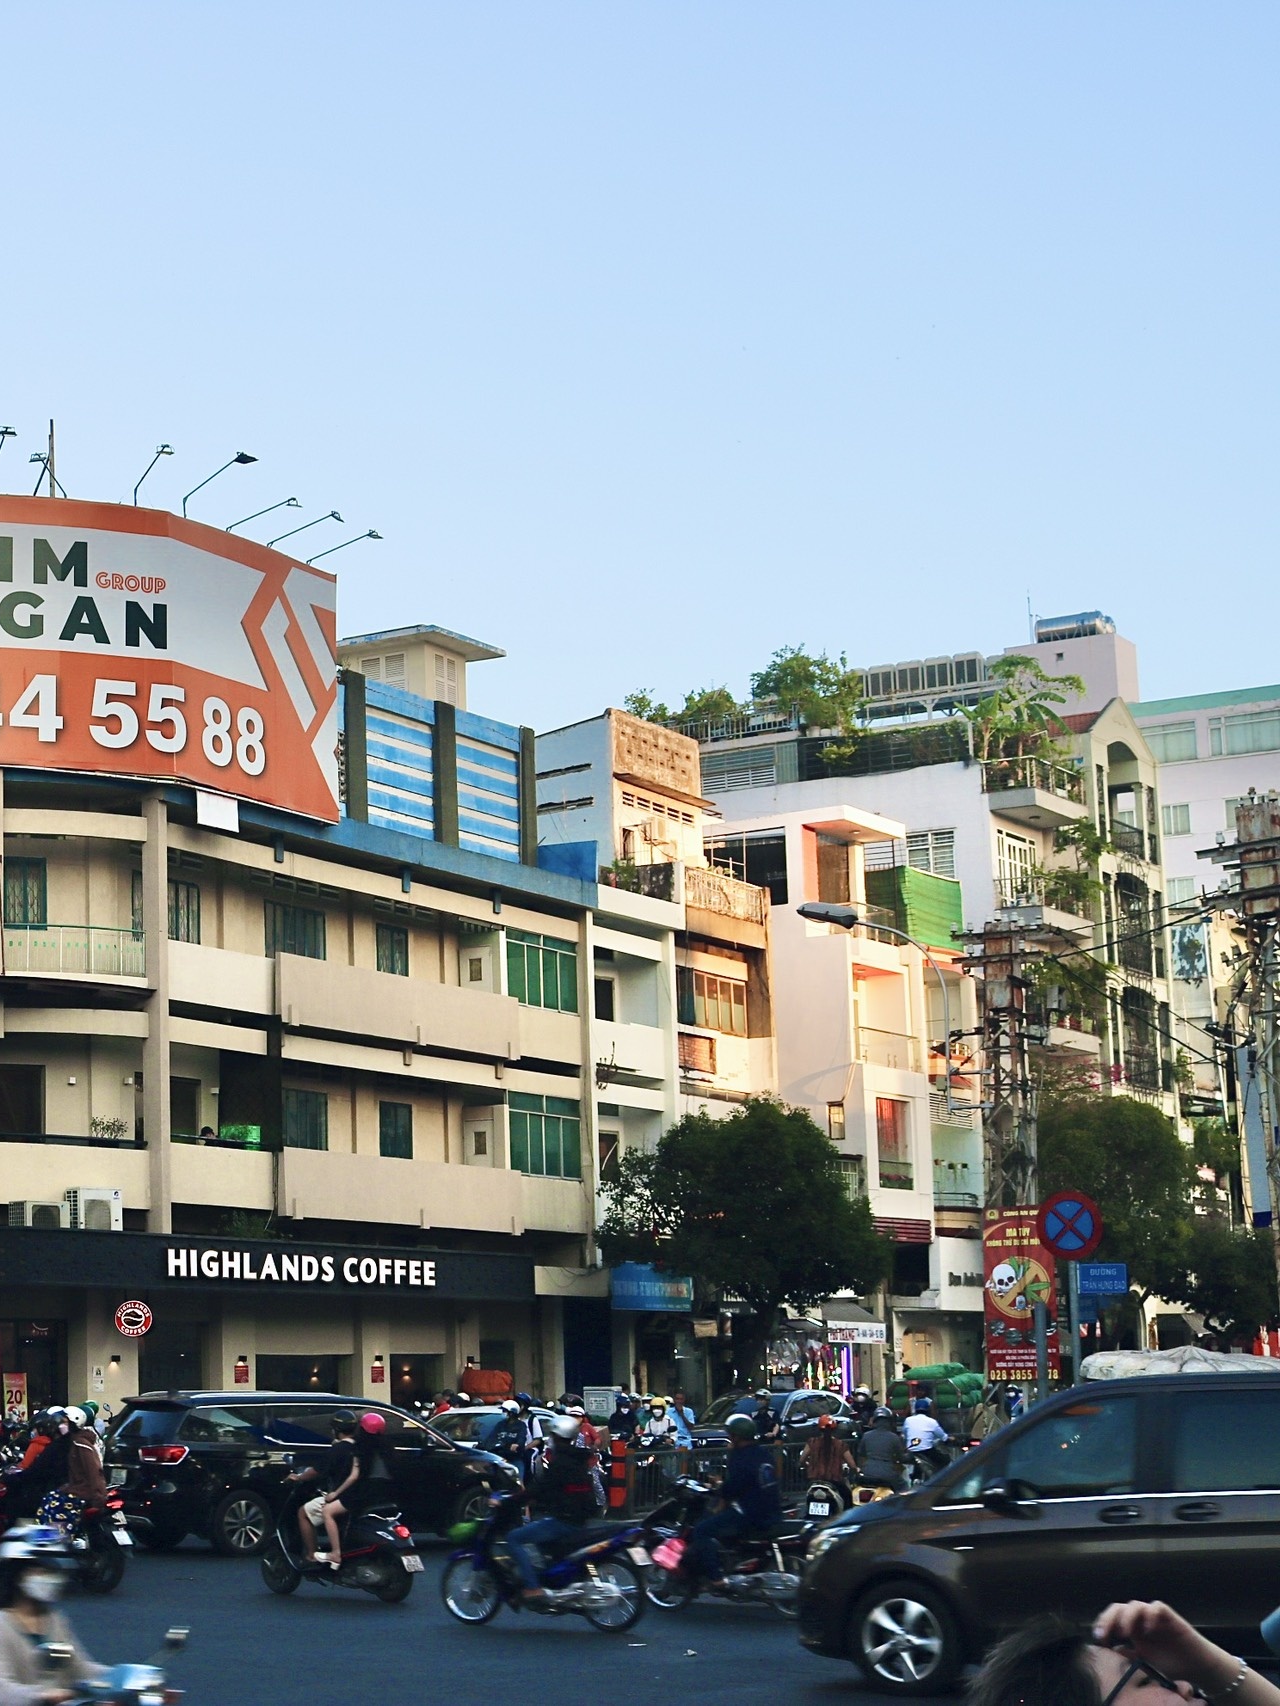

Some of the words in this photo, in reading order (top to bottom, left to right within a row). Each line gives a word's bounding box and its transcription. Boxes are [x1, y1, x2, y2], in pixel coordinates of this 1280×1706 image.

[95, 571, 167, 594] GROUP
[88, 678, 188, 754] 55
[201, 695, 266, 777] 88
[166, 1248, 334, 1283] HIGHLANDS
[343, 1256, 437, 1287] COFFEE
[117, 1302, 150, 1318] HIGHLANDS
[121, 1325, 146, 1335] COFFEE
[990, 1369, 1007, 1380] 028
[1010, 1369, 1032, 1380] 3855
